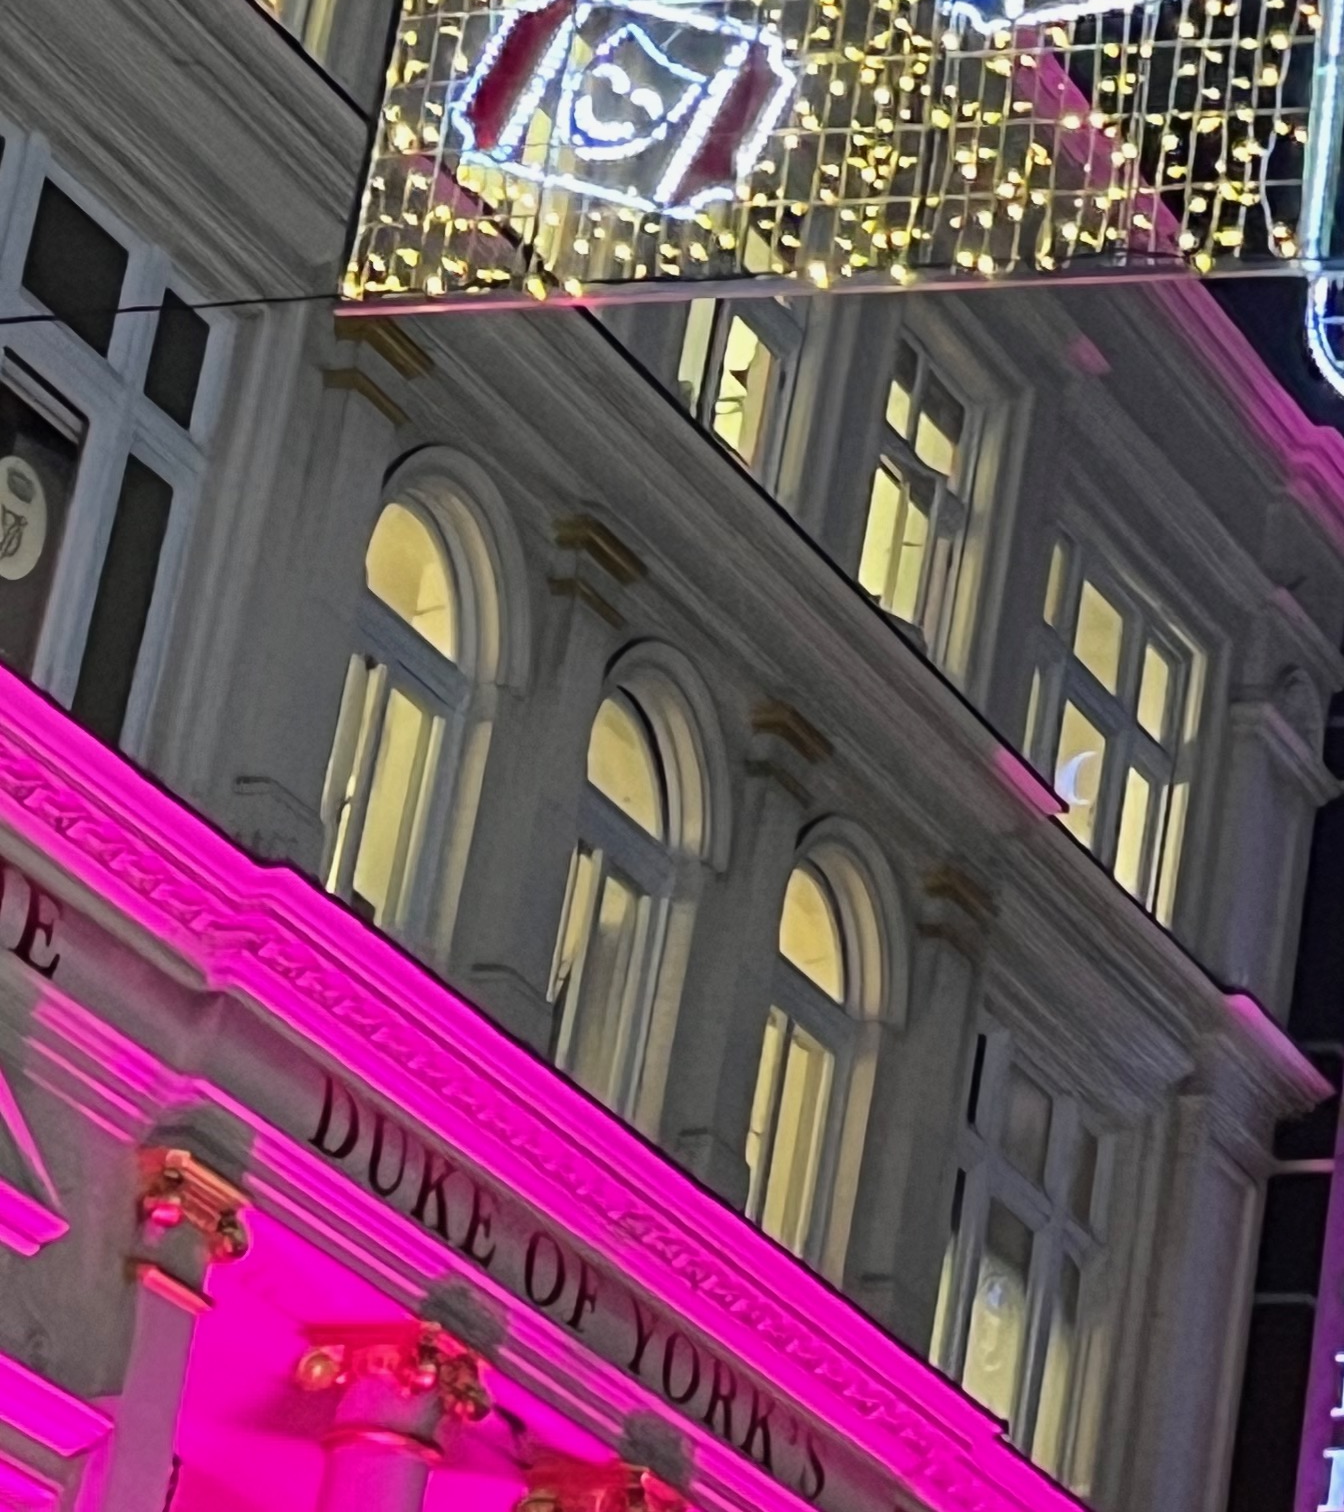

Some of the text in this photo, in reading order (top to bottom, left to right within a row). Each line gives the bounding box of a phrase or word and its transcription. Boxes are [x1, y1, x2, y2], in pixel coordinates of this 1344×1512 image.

[0, 854, 61, 980] E
[307, 1073, 826, 1502] DUKE OF YORK'S
